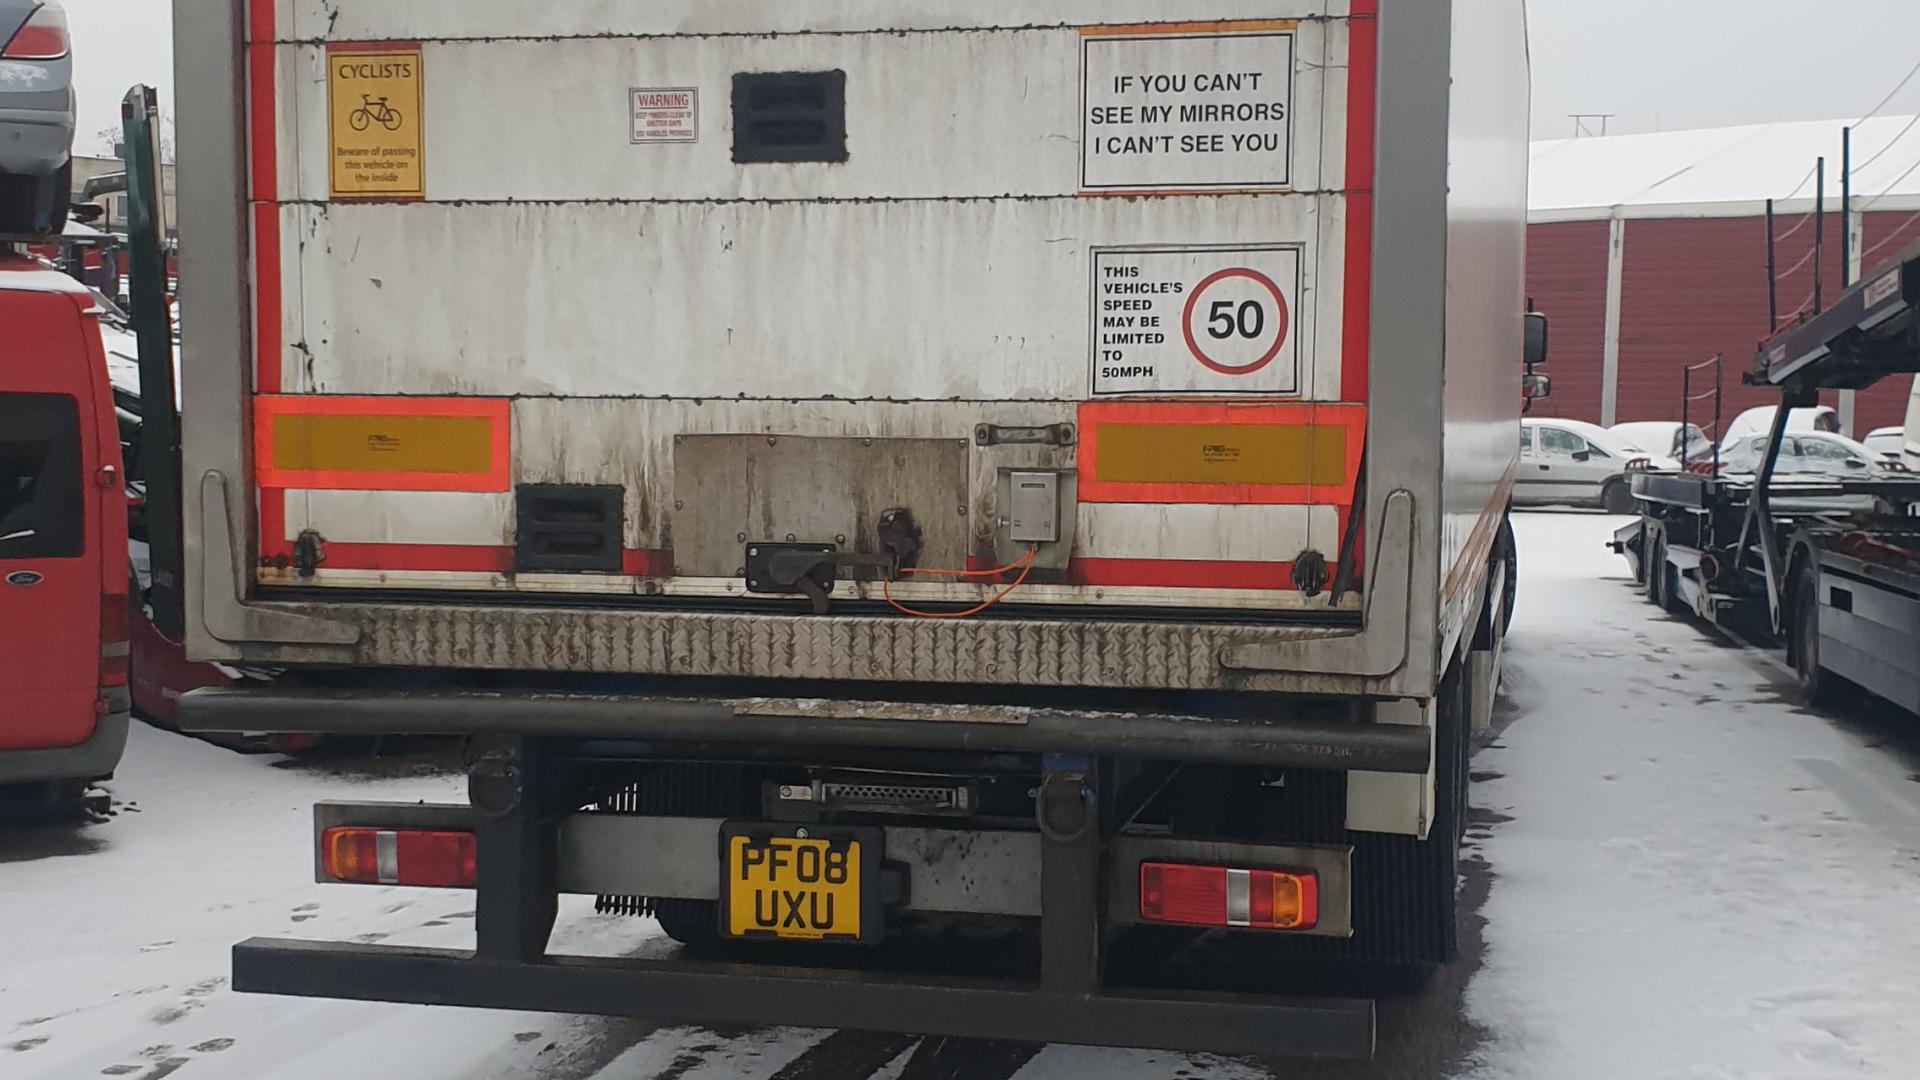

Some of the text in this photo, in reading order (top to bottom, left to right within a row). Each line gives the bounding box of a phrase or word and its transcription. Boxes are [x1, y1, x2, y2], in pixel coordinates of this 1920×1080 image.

[339, 64, 412, 79] CYCLISTS
[1114, 73, 1262, 93] IF YOU CAN'T
[638, 94, 689, 107] WARNING
[1091, 103, 1284, 124] SEE MY MIRRORS
[1095, 133, 1278, 154] I CAN'T SEE YOU
[337, 146, 416, 158] Beware of passing
[345, 161, 361, 169] this
[363, 160, 394, 169] vehicle
[355, 173, 399, 182] the inside
[1104, 267, 1139, 278] THIS
[1104, 282, 1183, 294] VEHICLE'S
[1104, 300, 1152, 311] SPEED
[1103, 316, 1160, 327] MAY BE
[1207, 300, 1264, 339] 50
[1103, 333, 1164, 344] LIMITED
[1103, 350, 1122, 361] TO
[1102, 366, 1153, 378] 50MPH
[742, 842, 848, 884] PF08
[755, 890, 834, 929] UXU
